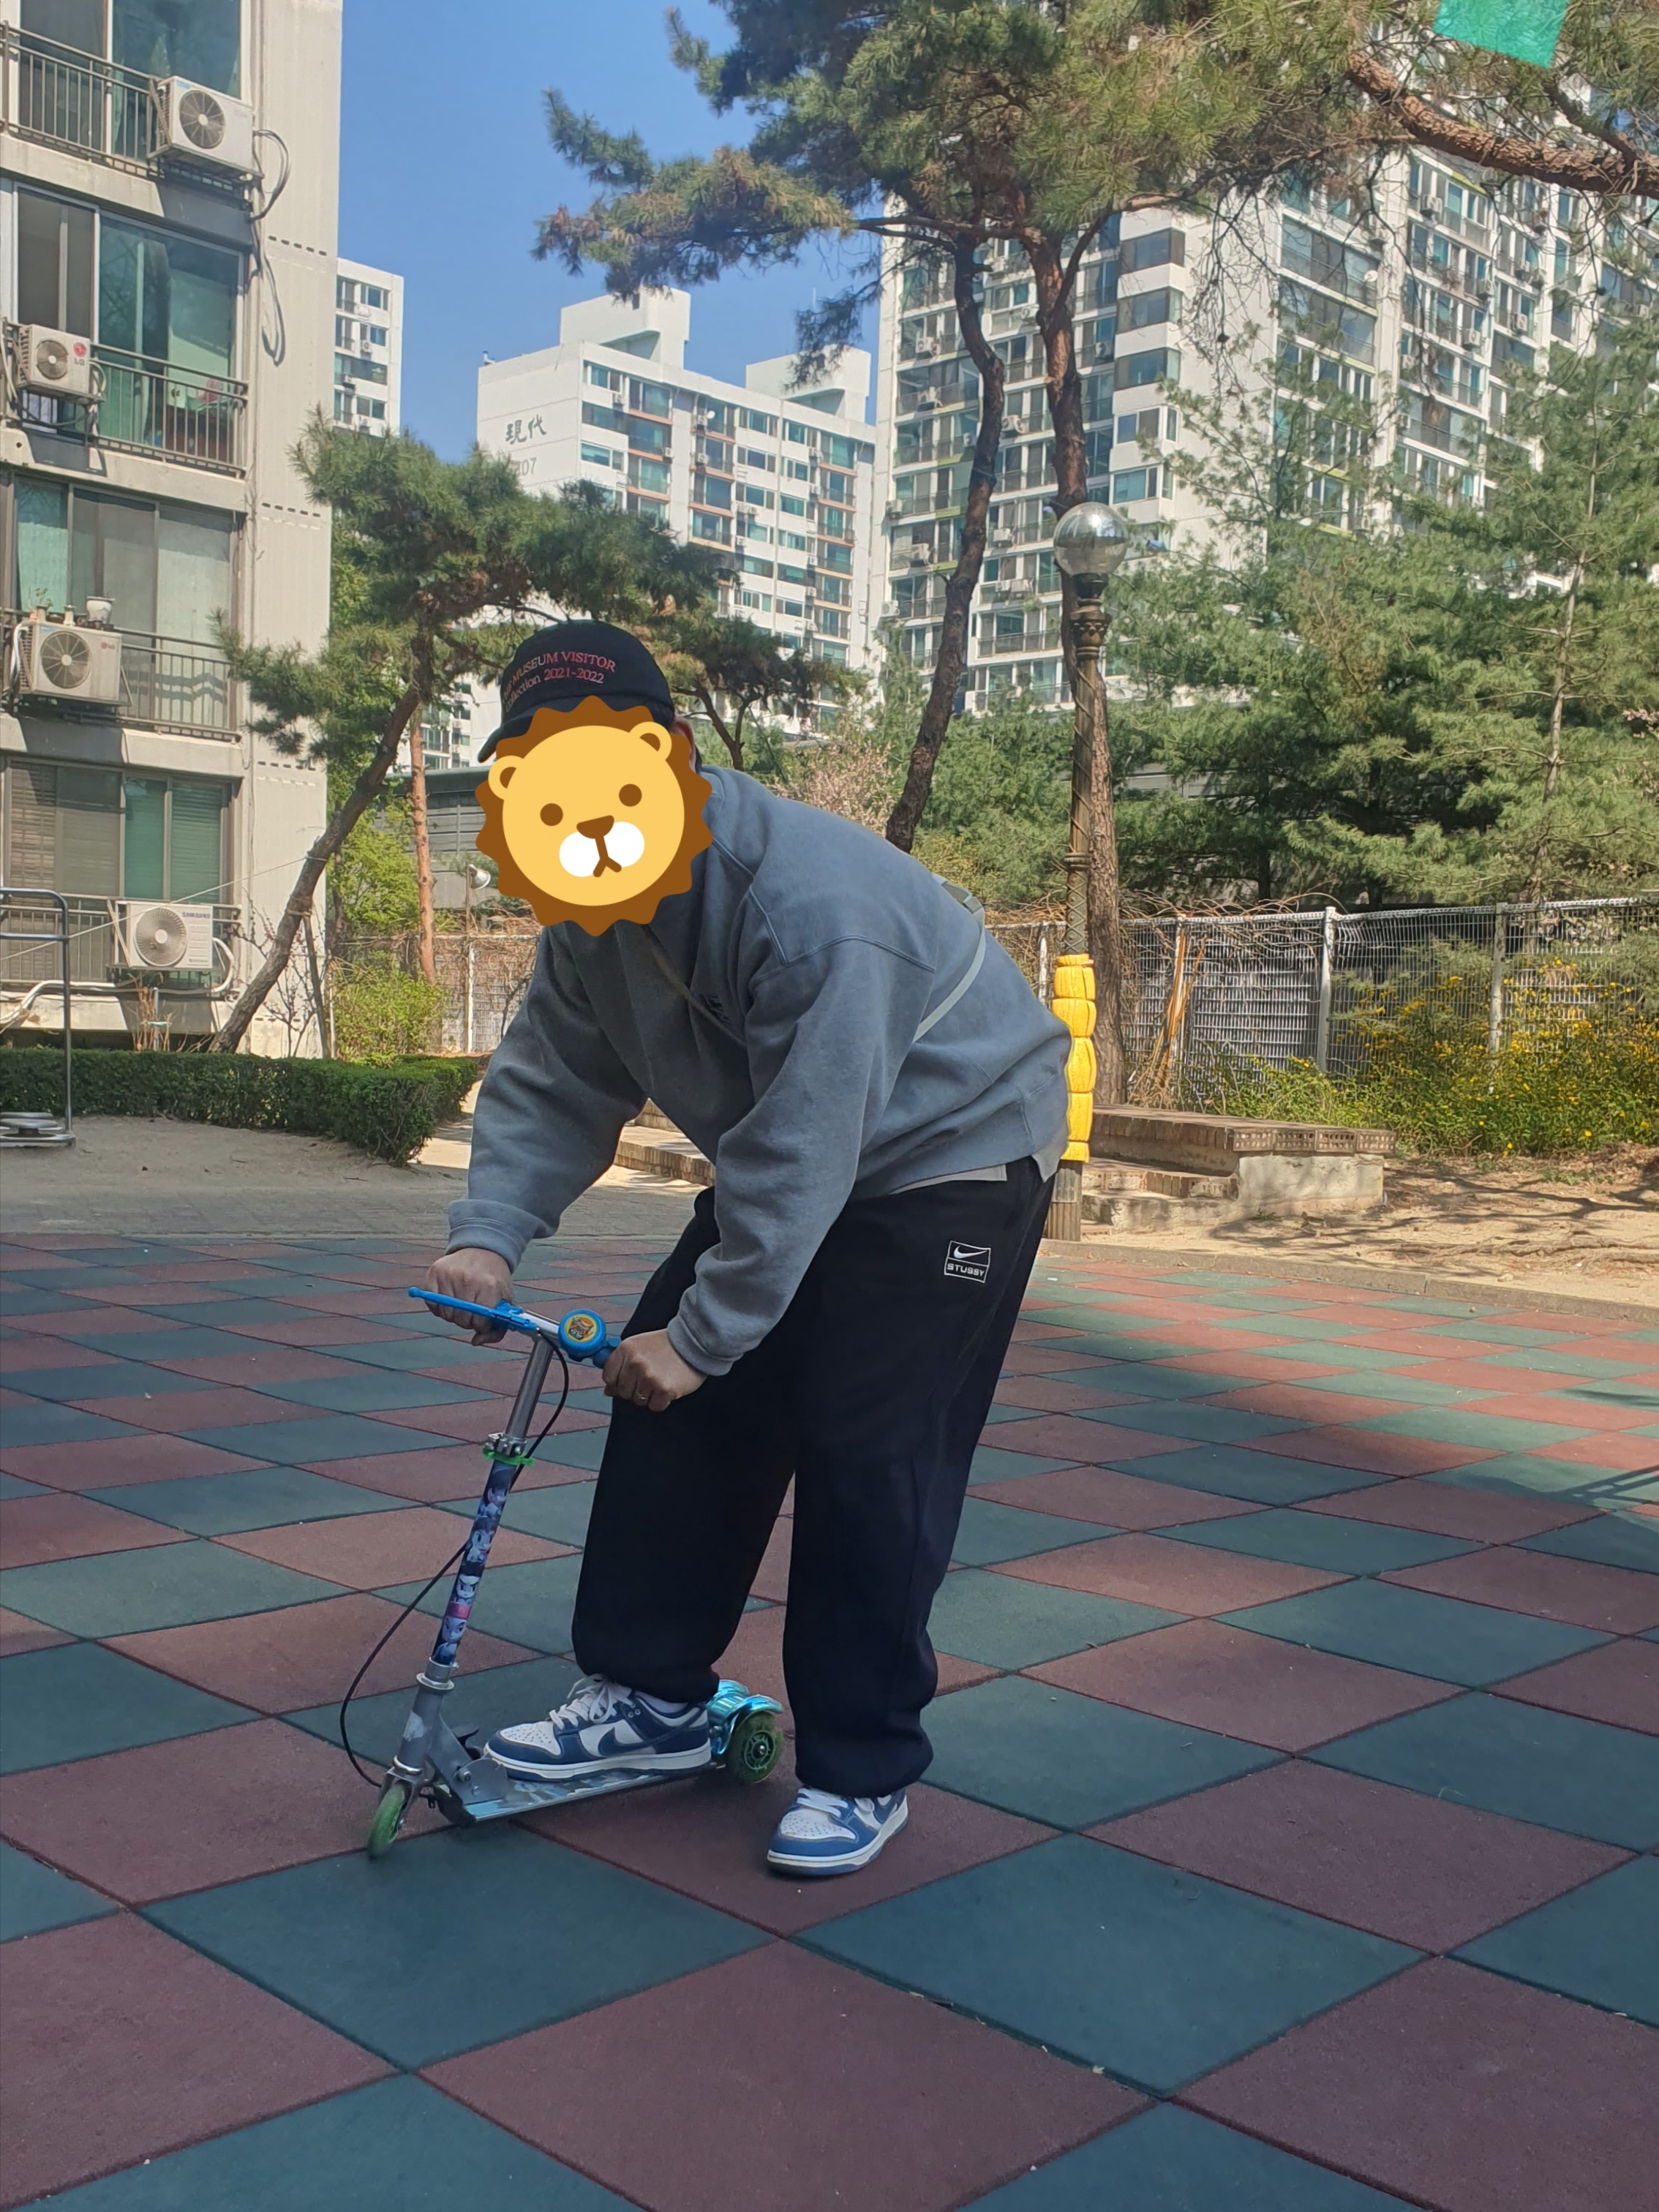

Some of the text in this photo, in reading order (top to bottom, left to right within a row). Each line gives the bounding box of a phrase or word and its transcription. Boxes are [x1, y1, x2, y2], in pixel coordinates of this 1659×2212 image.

[505, 414, 547, 445] 現代
[512, 652, 558, 685] MUSEUM
[560, 652, 616, 672] VISITOR
[543, 667, 605, 684] 2021-2022
[947, 1263, 985, 1277] STUSSY
